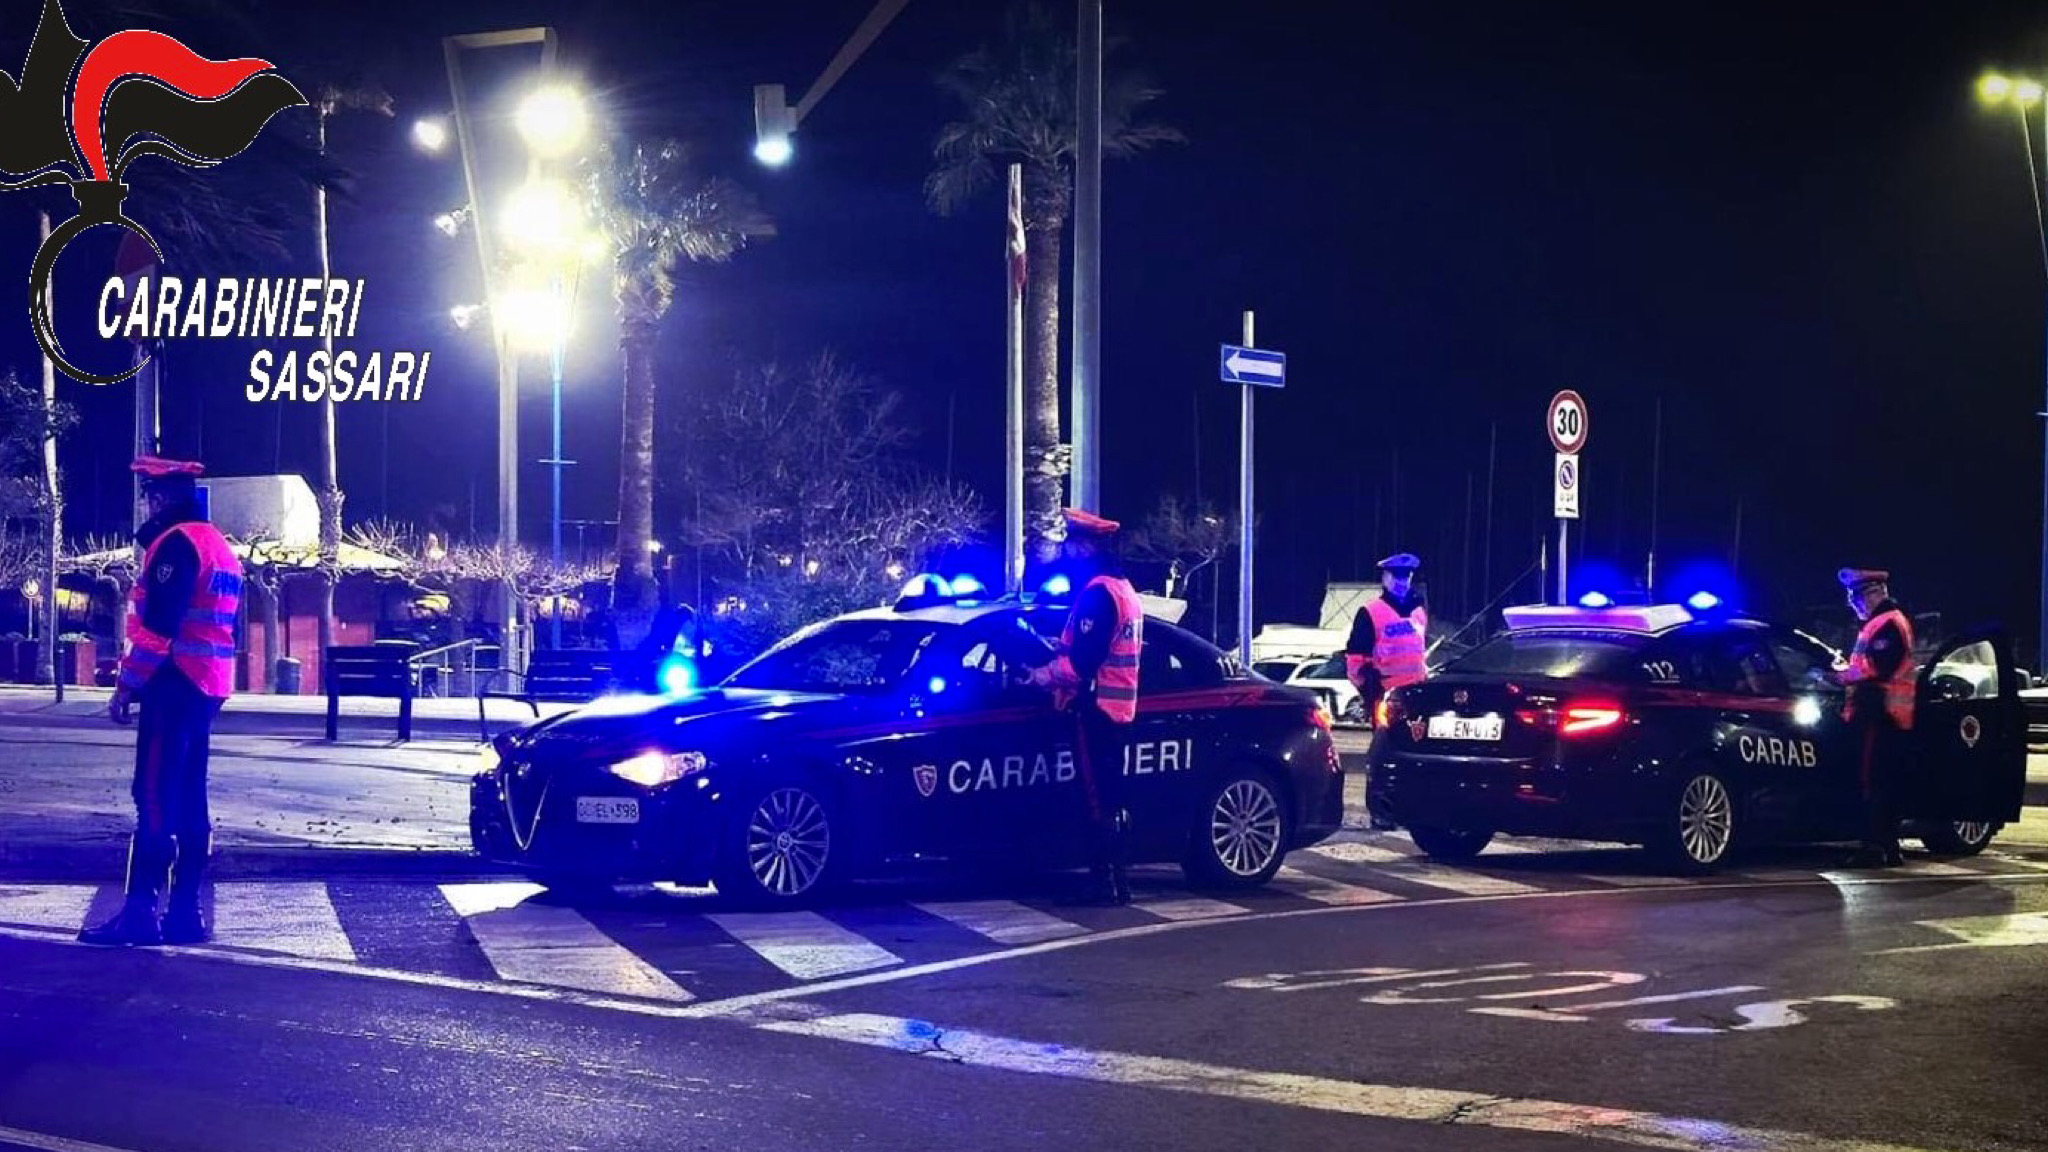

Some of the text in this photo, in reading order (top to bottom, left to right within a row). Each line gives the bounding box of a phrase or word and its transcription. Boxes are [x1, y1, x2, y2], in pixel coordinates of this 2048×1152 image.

[1557, 408, 1579, 435] 30
[1642, 661, 1680, 679] 112
[948, 739, 1192, 793] CARABIERI
